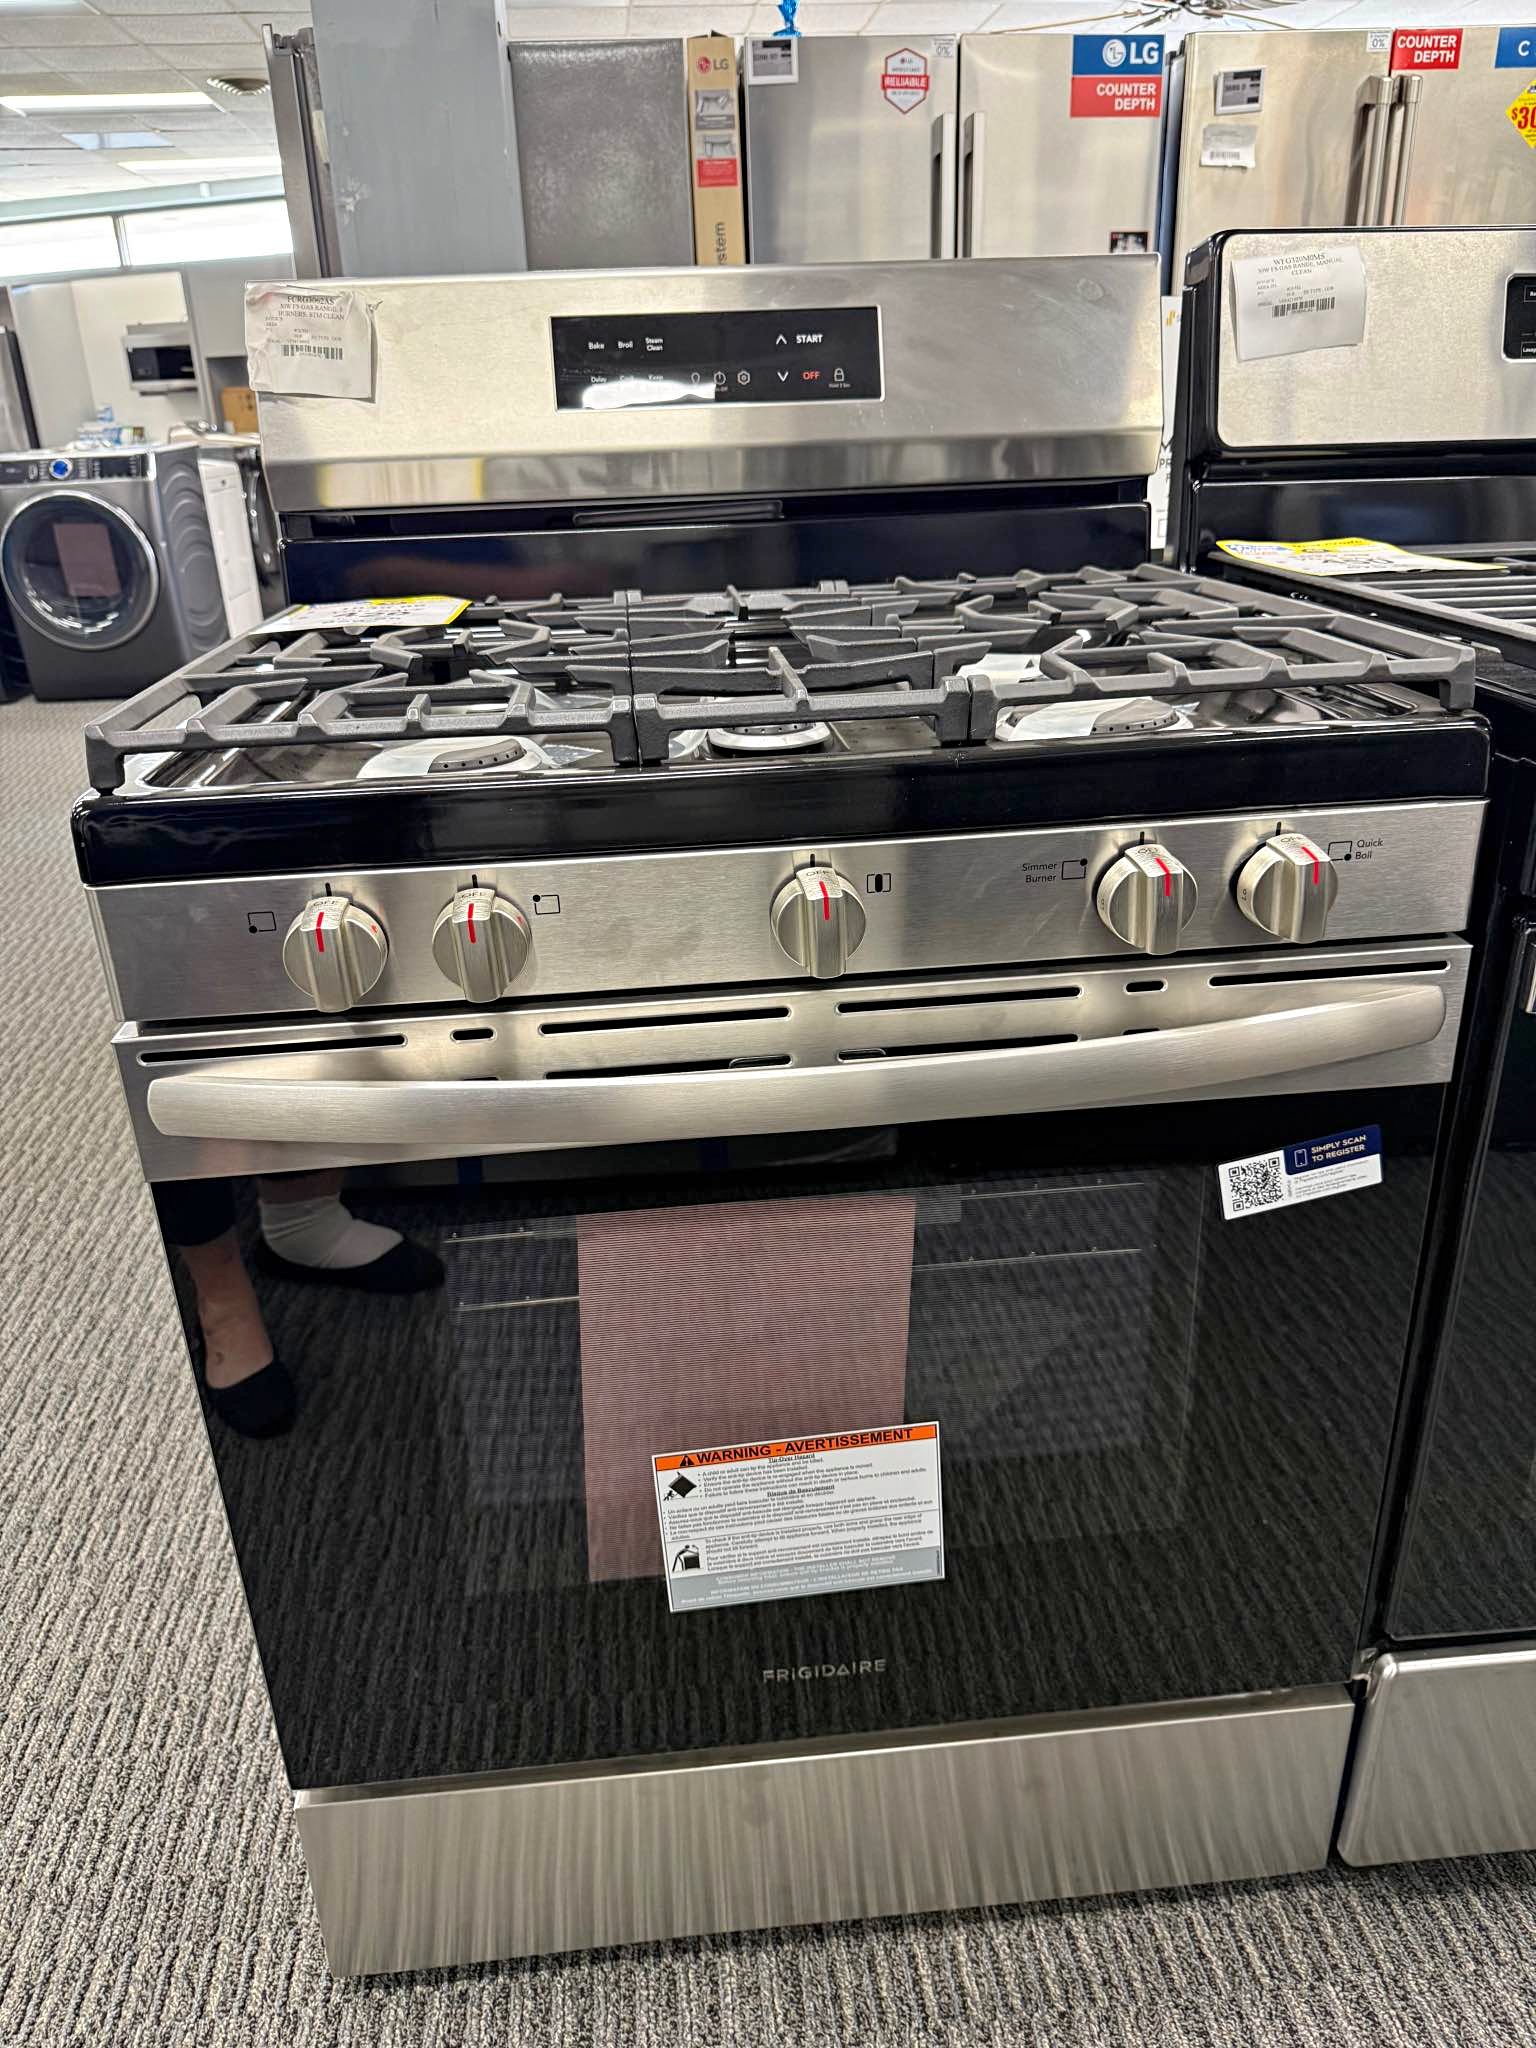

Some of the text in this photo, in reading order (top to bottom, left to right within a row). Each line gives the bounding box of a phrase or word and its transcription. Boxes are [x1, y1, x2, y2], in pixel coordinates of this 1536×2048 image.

[1372, 37, 1386, 48] 0%
[1397, 34, 1457, 49] COUNTER
[1129, 41, 1159, 65] LG
[1413, 50, 1455, 63] DEPTH
[713, 57, 729, 71] LG
[1096, 82, 1157, 96] COUNTER
[1114, 97, 1155, 111] DEPTH
[715, 222, 728, 265] stem
[617, 341, 633, 349] Broil
[795, 334, 823, 344] START
[588, 342, 605, 350] Bake
[803, 371, 820, 380] OFF
[1356, 837, 1384, 849] Quick
[1354, 851, 1373, 861] Boil
[1021, 861, 1058, 872] Simmer
[1024, 872, 1057, 884] Burner
[1311, 1134, 1367, 1155] SIMPLY SCAN
[1311, 1144, 1366, 1163] TO REGISTER
[697, 1445, 771, 1464] WARNING
[784, 1428, 913, 1454] AVERTISSEMENT
[762, 1658, 887, 1684] FRIGIDAIRE
